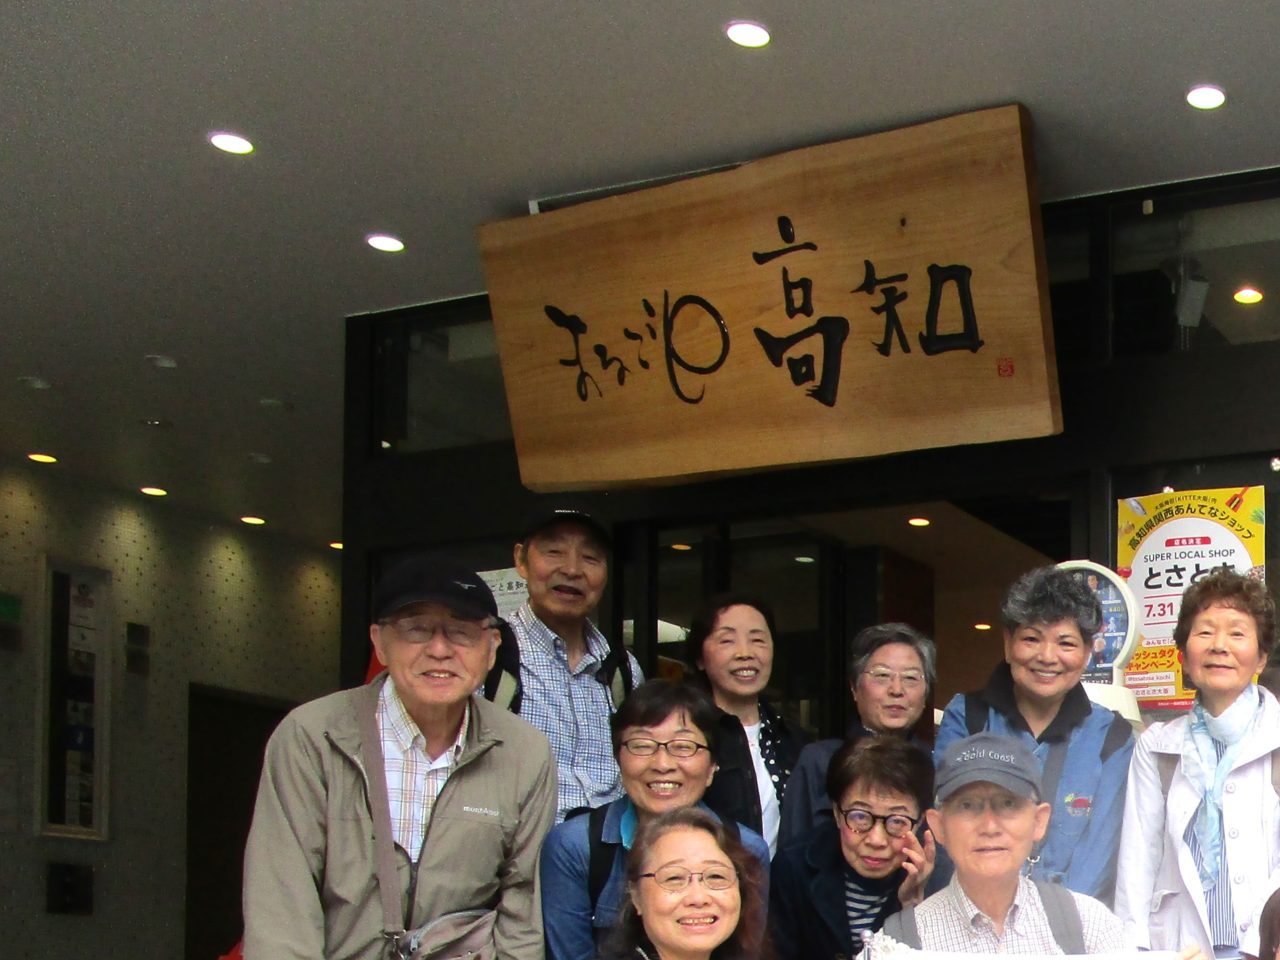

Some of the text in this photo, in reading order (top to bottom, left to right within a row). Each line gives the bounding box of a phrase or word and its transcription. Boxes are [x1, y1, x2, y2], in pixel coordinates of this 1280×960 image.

[1128, 503, 1255, 550] 高知県関西あんてなショップ
[1144, 549, 1235, 563] SUPER LOCAL SHOP
[1144, 602, 1174, 618] 7.31
[1131, 648, 1175, 660] ッシュタグ
[1126, 660, 1175, 671] キャンペーン
[988, 751, 1015, 764] Coast
